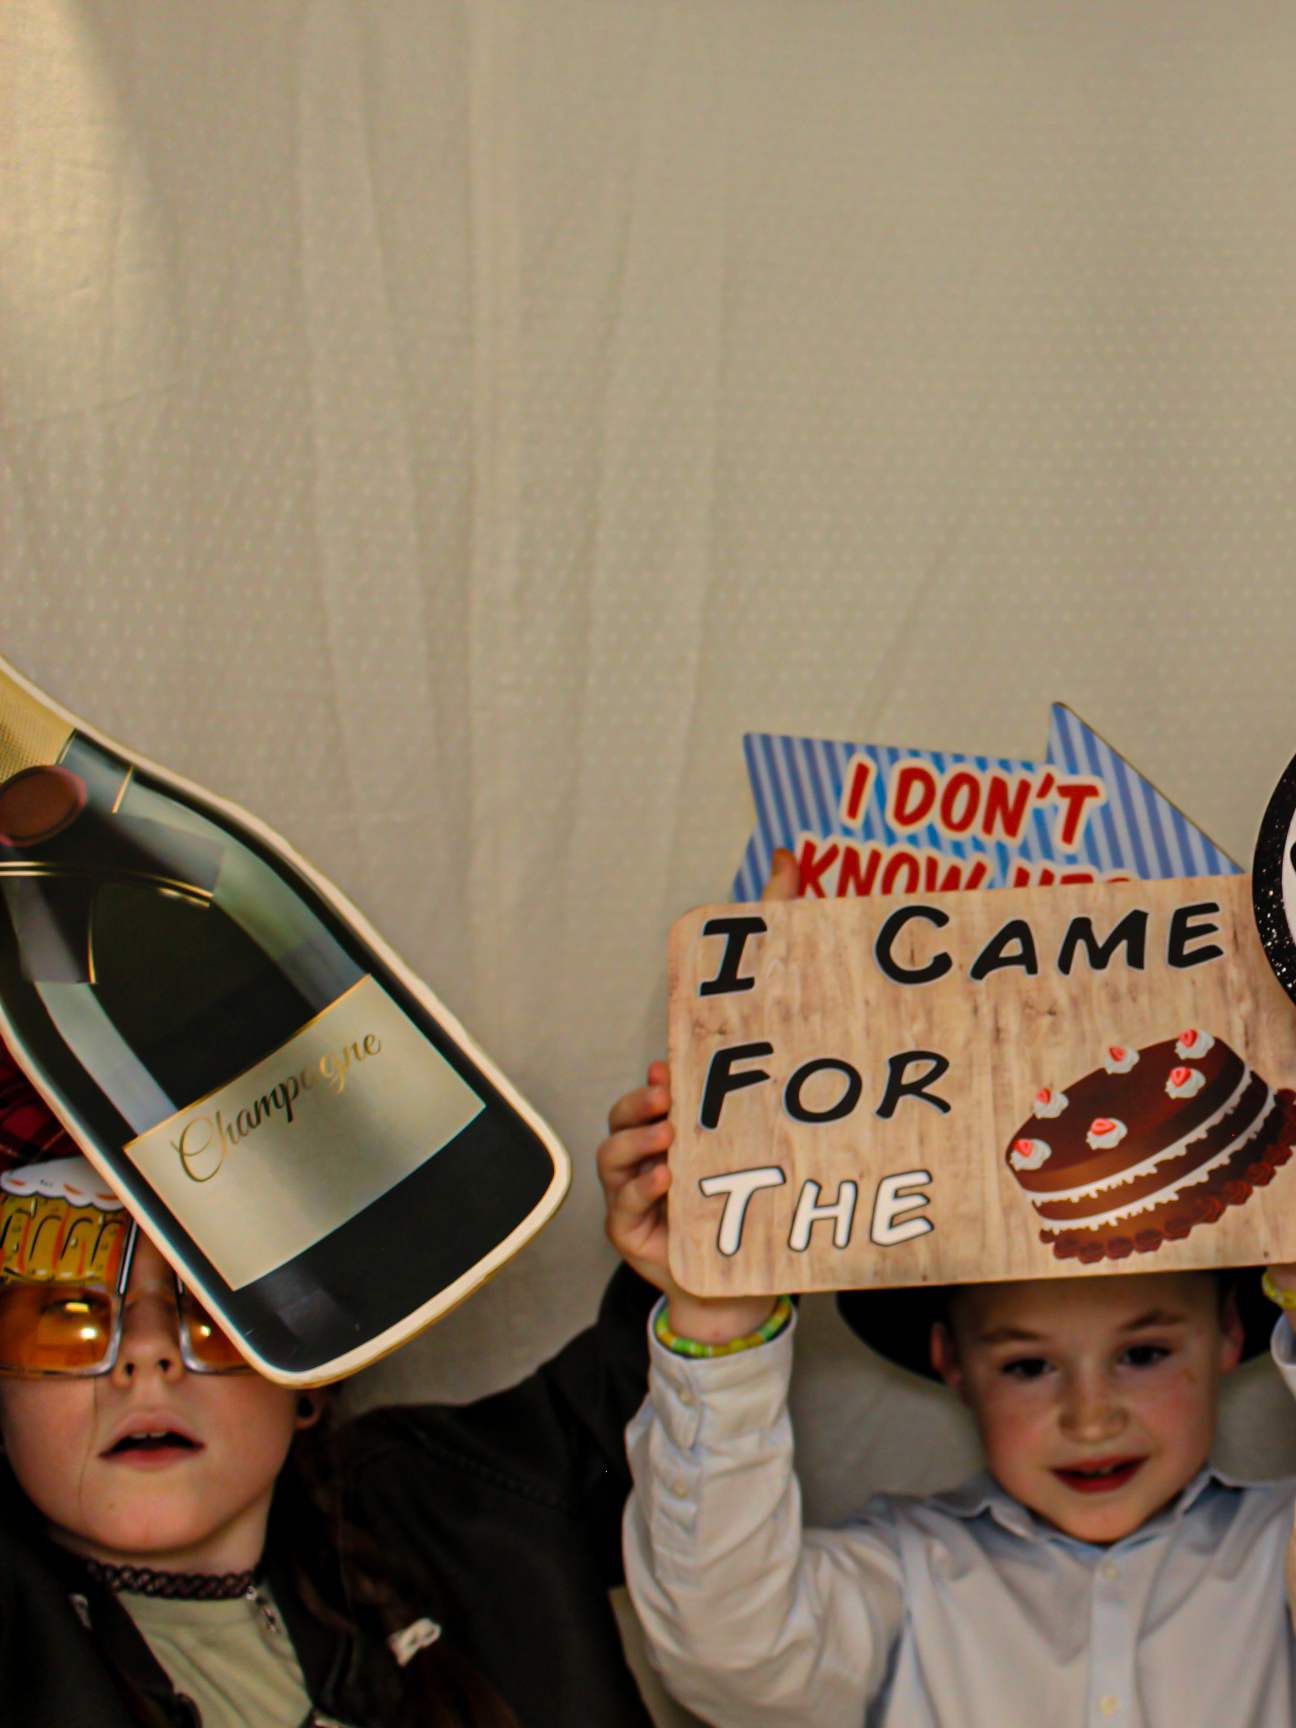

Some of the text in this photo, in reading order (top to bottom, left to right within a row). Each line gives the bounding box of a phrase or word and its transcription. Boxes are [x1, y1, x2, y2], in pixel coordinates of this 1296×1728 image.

[847, 762, 1100, 846] I DON'T
[797, 839, 986, 898] KNOW
[699, 902, 1224, 997] I CAME
[170, 1032, 382, 1183] Champagne
[699, 1041, 952, 1131] FOR
[699, 1165, 934, 1257] THE
